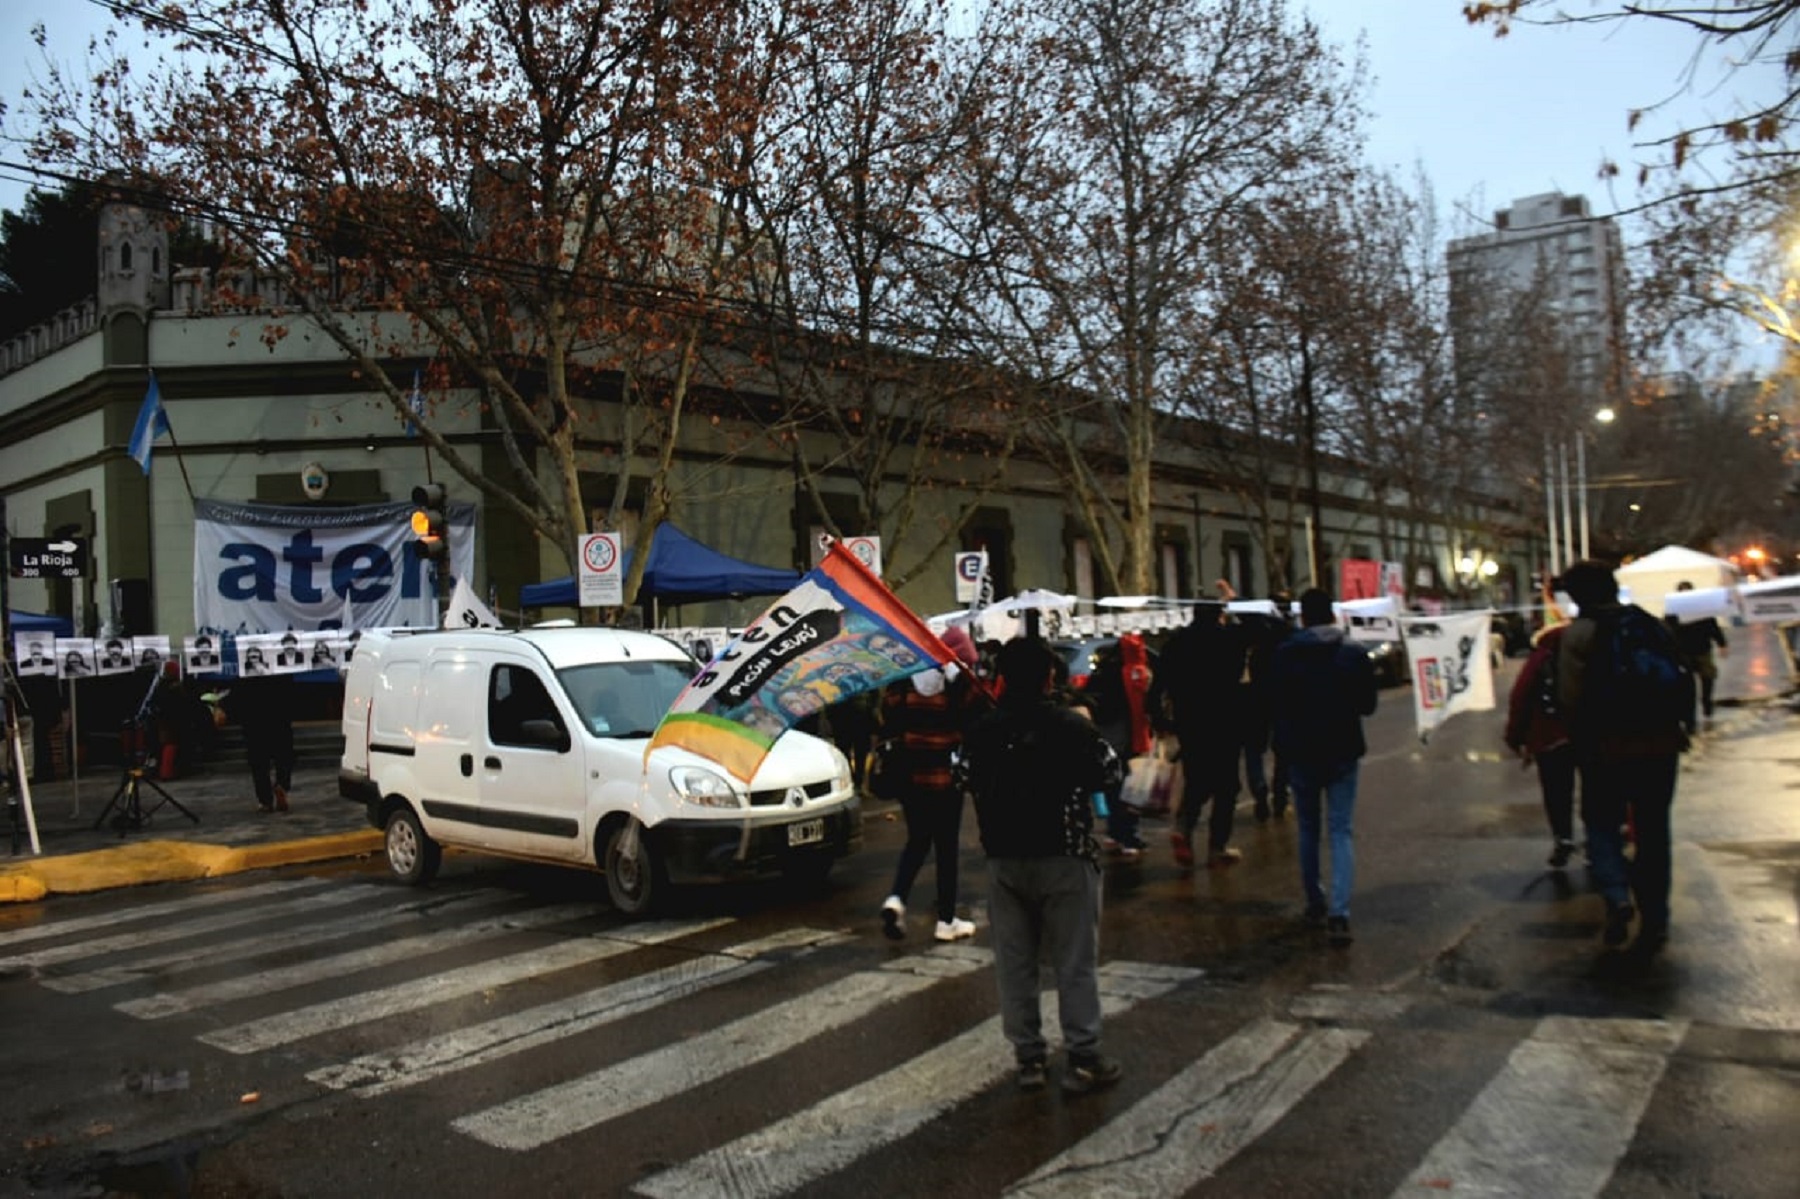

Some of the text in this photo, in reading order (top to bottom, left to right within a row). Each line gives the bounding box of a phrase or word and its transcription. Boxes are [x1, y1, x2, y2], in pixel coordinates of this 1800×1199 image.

[23, 554, 73, 567] La Rioja
[965, 560, 979, 577] E
